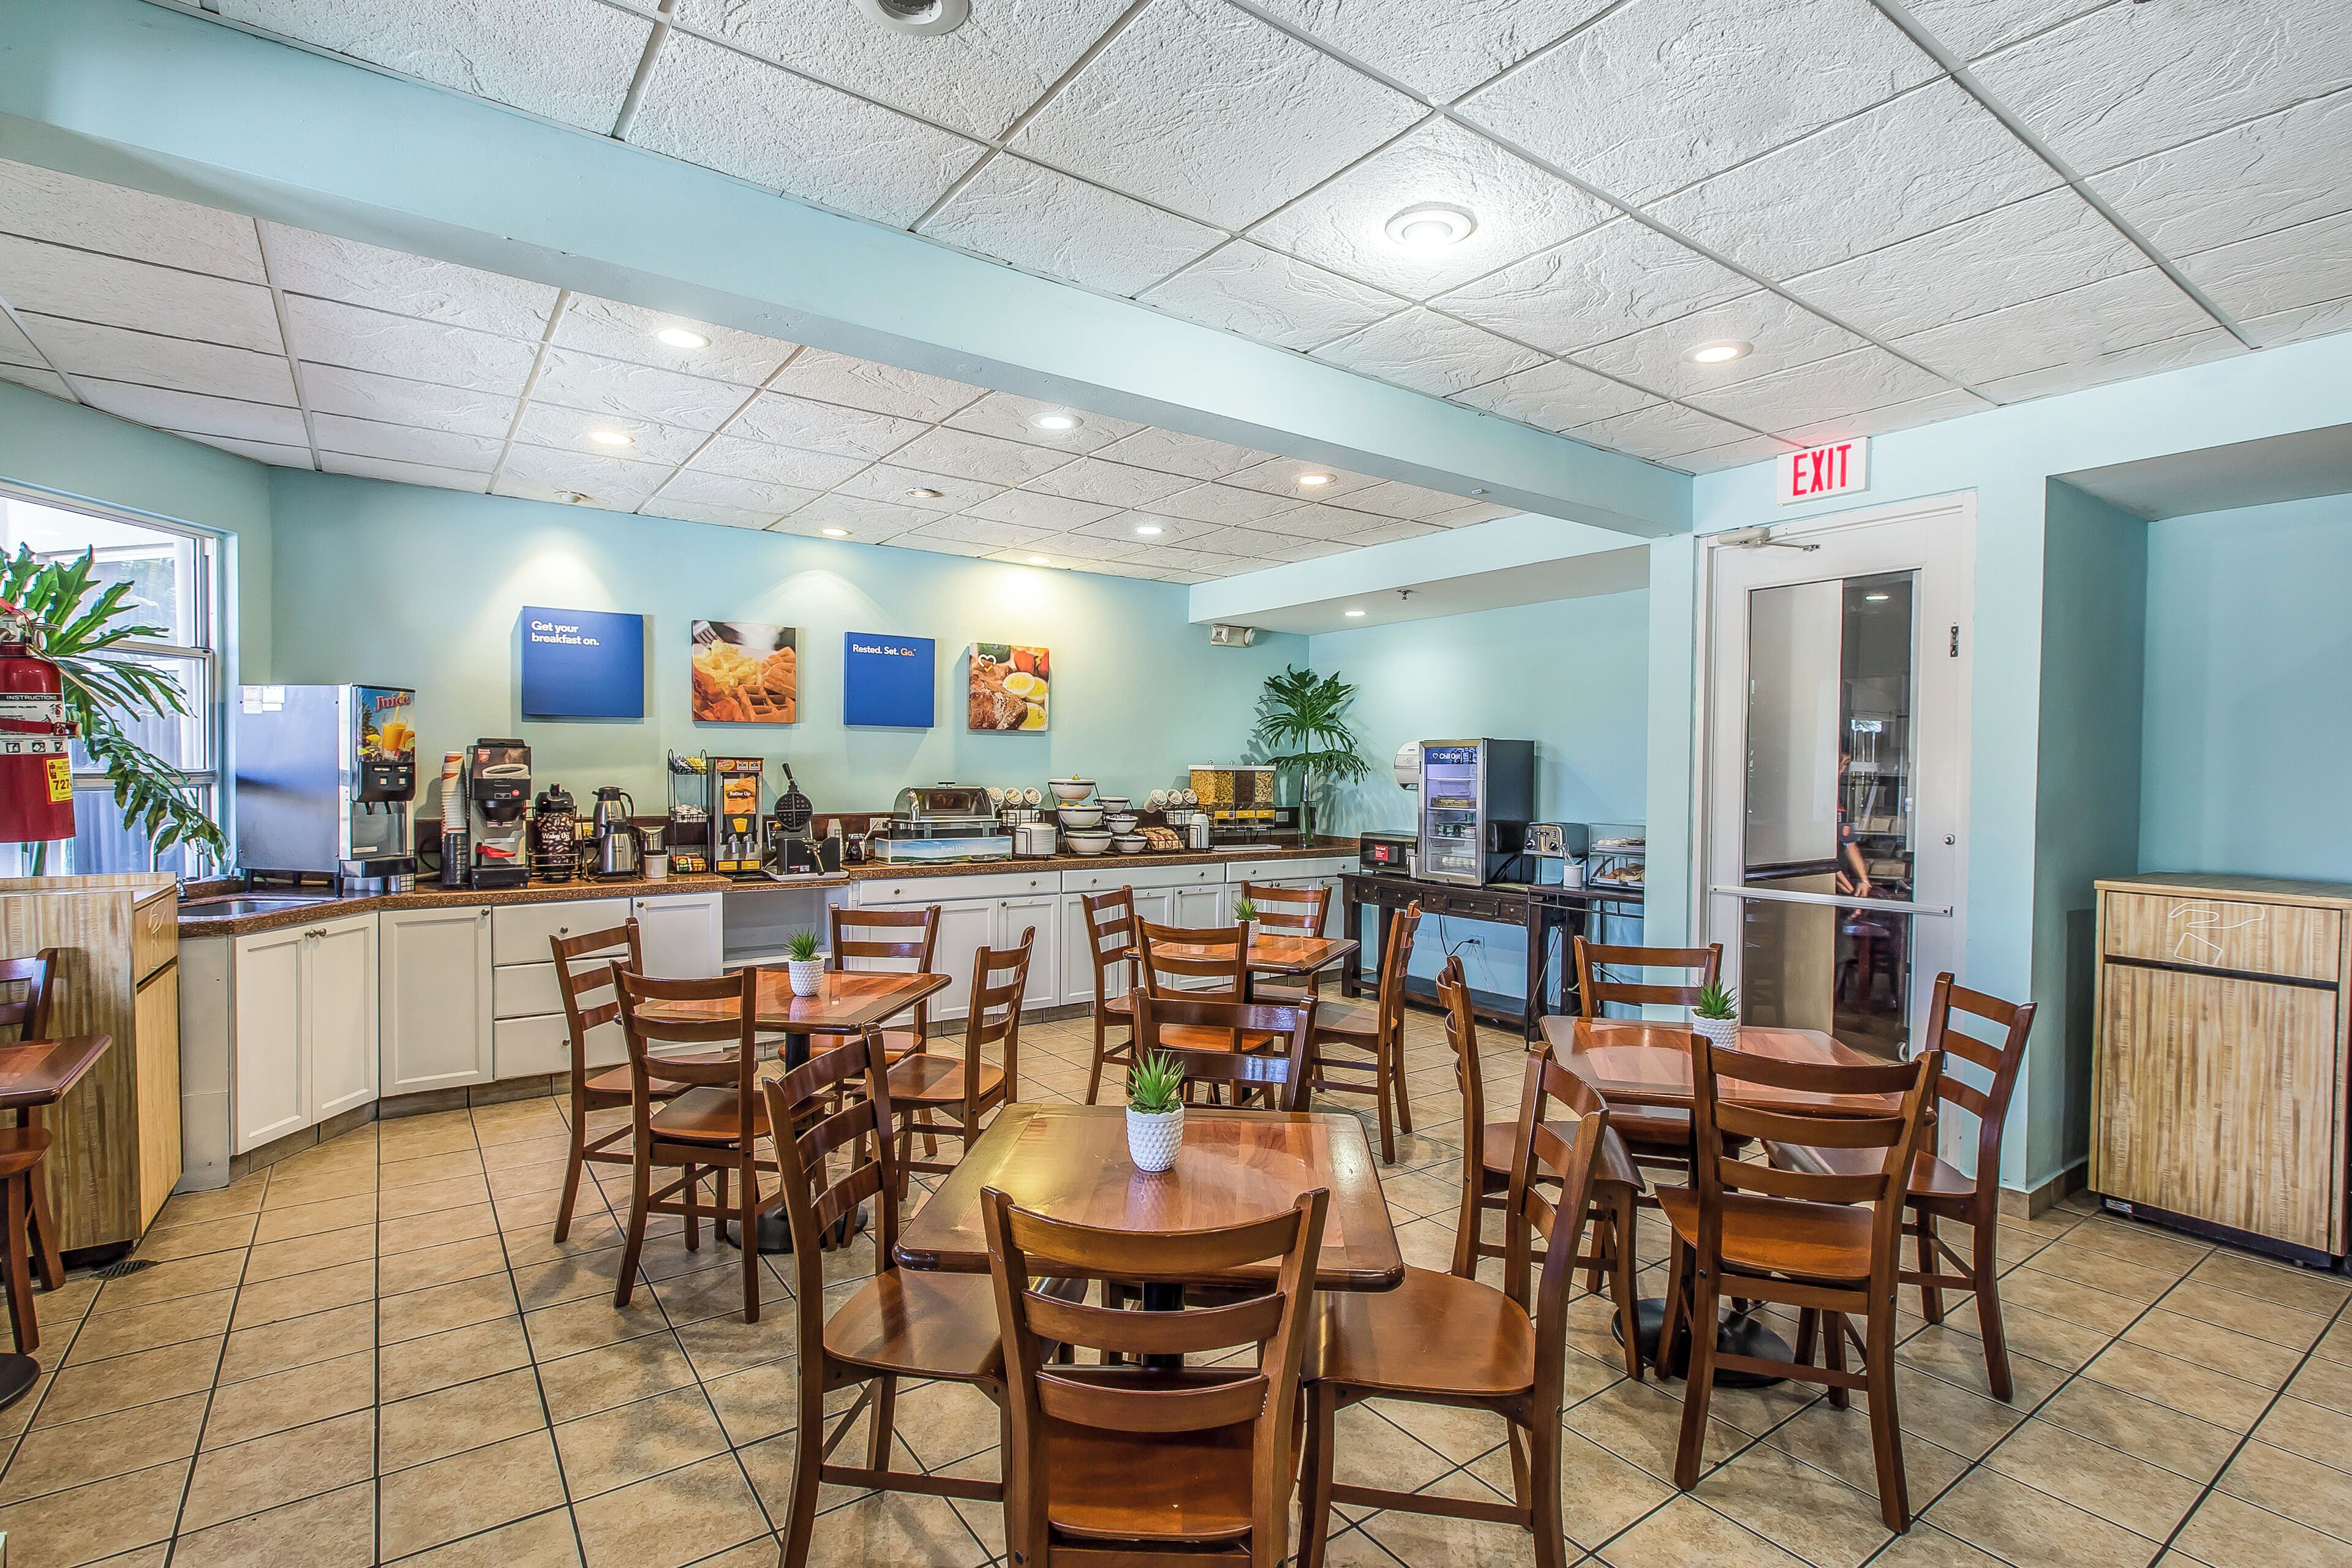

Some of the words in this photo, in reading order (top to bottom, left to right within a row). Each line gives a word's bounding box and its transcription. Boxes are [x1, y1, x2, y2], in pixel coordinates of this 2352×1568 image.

[1792, 443, 1852, 497] EXIT
[531, 620, 553, 631] Get
[554, 625, 579, 633] your
[531, 632, 581, 644] breakfast
[853, 644, 883, 654] Rested.
[884, 646, 899, 655] Set.
[374, 694, 410, 711] Juice
